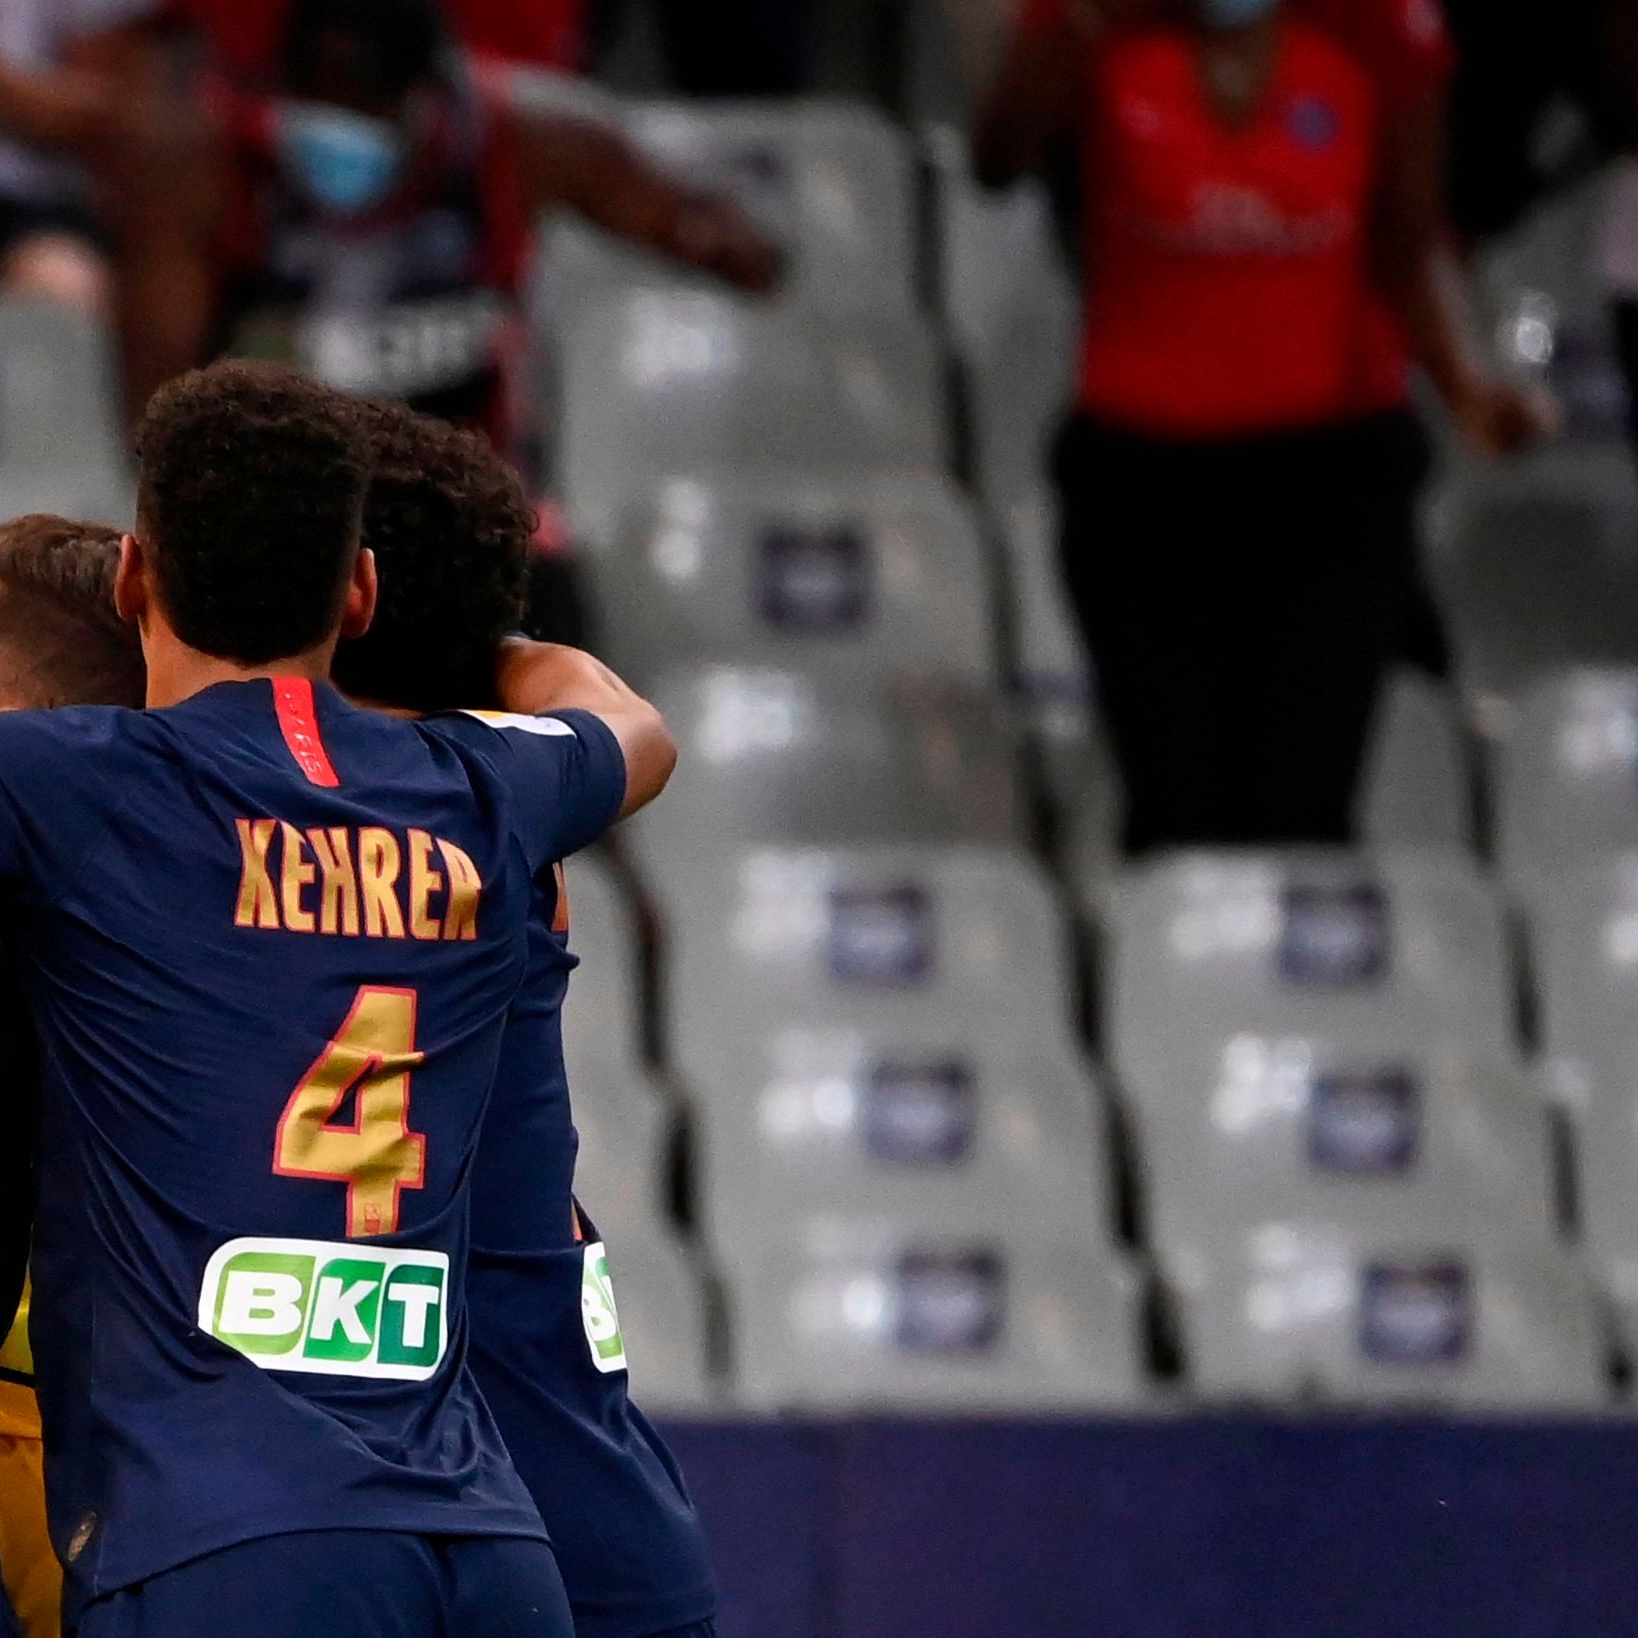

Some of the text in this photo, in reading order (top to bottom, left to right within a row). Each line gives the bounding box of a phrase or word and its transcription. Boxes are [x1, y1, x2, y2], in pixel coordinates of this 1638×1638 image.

[232, 816, 483, 942] KEHRER
[271, 983, 427, 1240] 4
[216, 1267, 442, 1352] BKT
